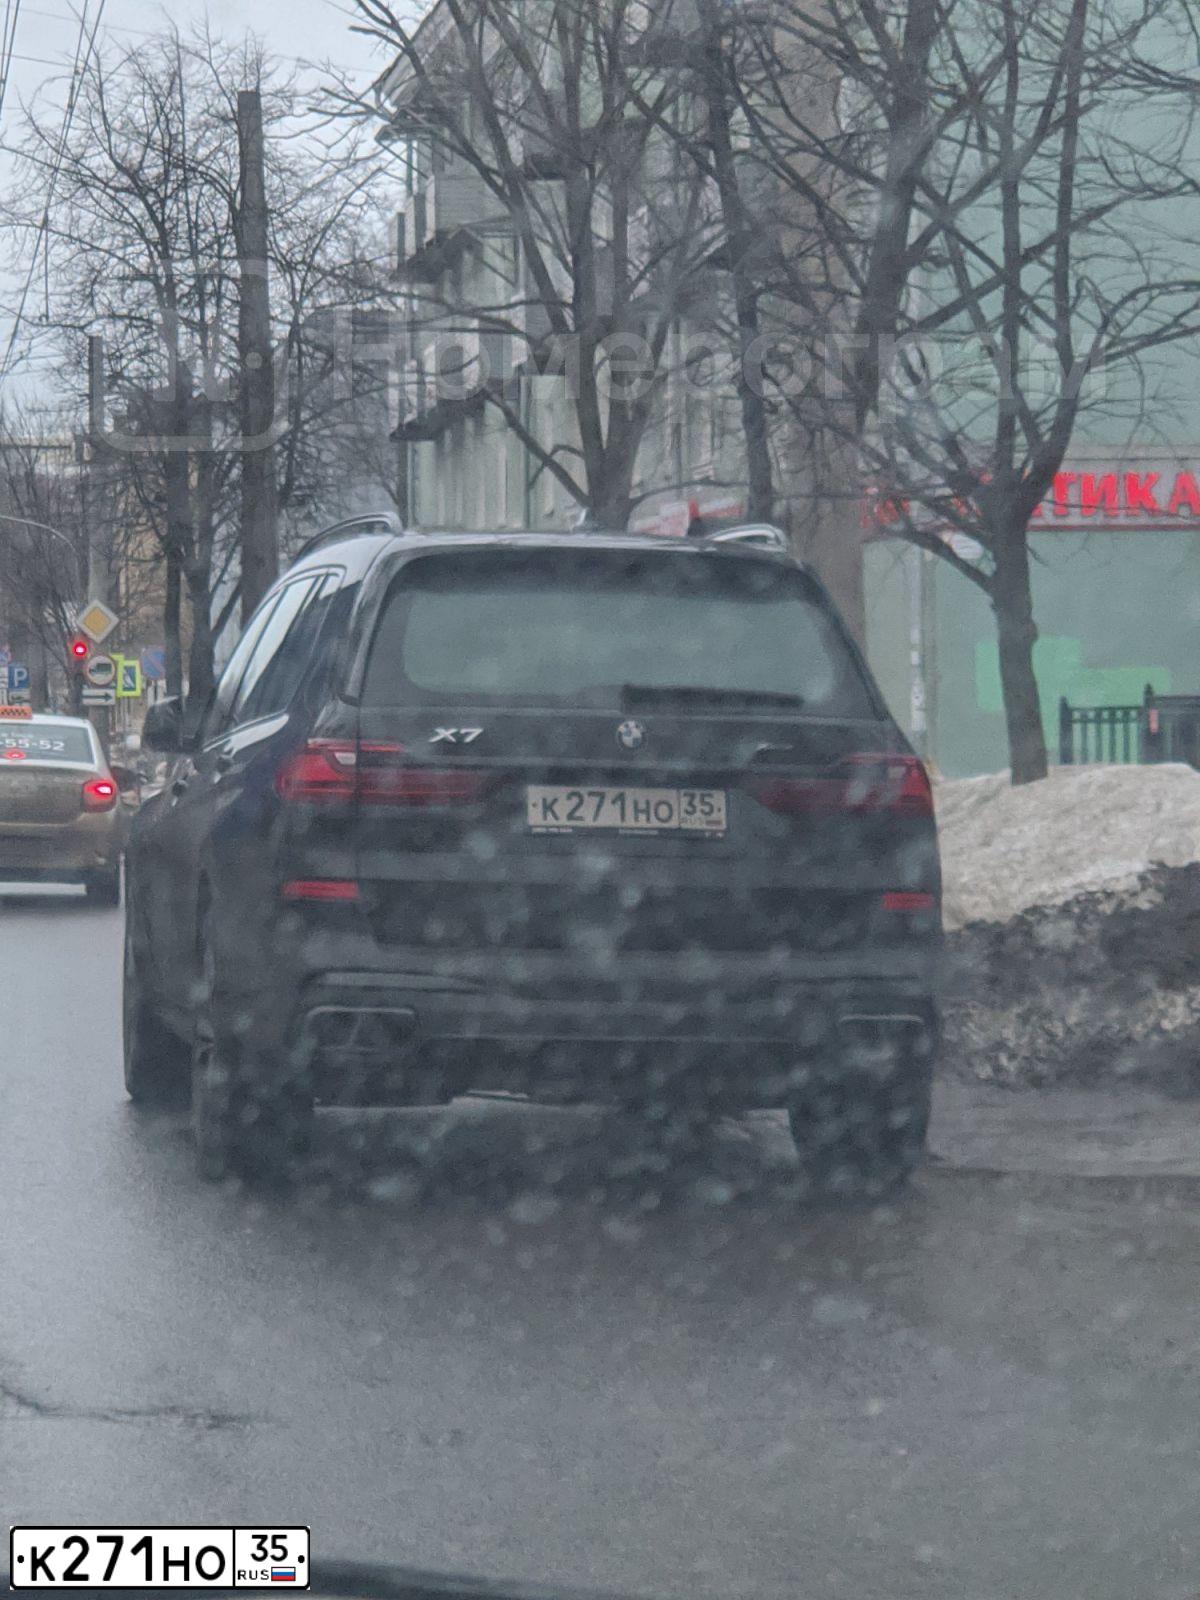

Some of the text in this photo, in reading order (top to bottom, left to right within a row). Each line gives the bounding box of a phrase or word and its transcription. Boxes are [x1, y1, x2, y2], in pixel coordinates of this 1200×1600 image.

[14, 667, 28, 688] P
[428, 727, 484, 743] X7
[541, 791, 714, 824] К271НО 35
